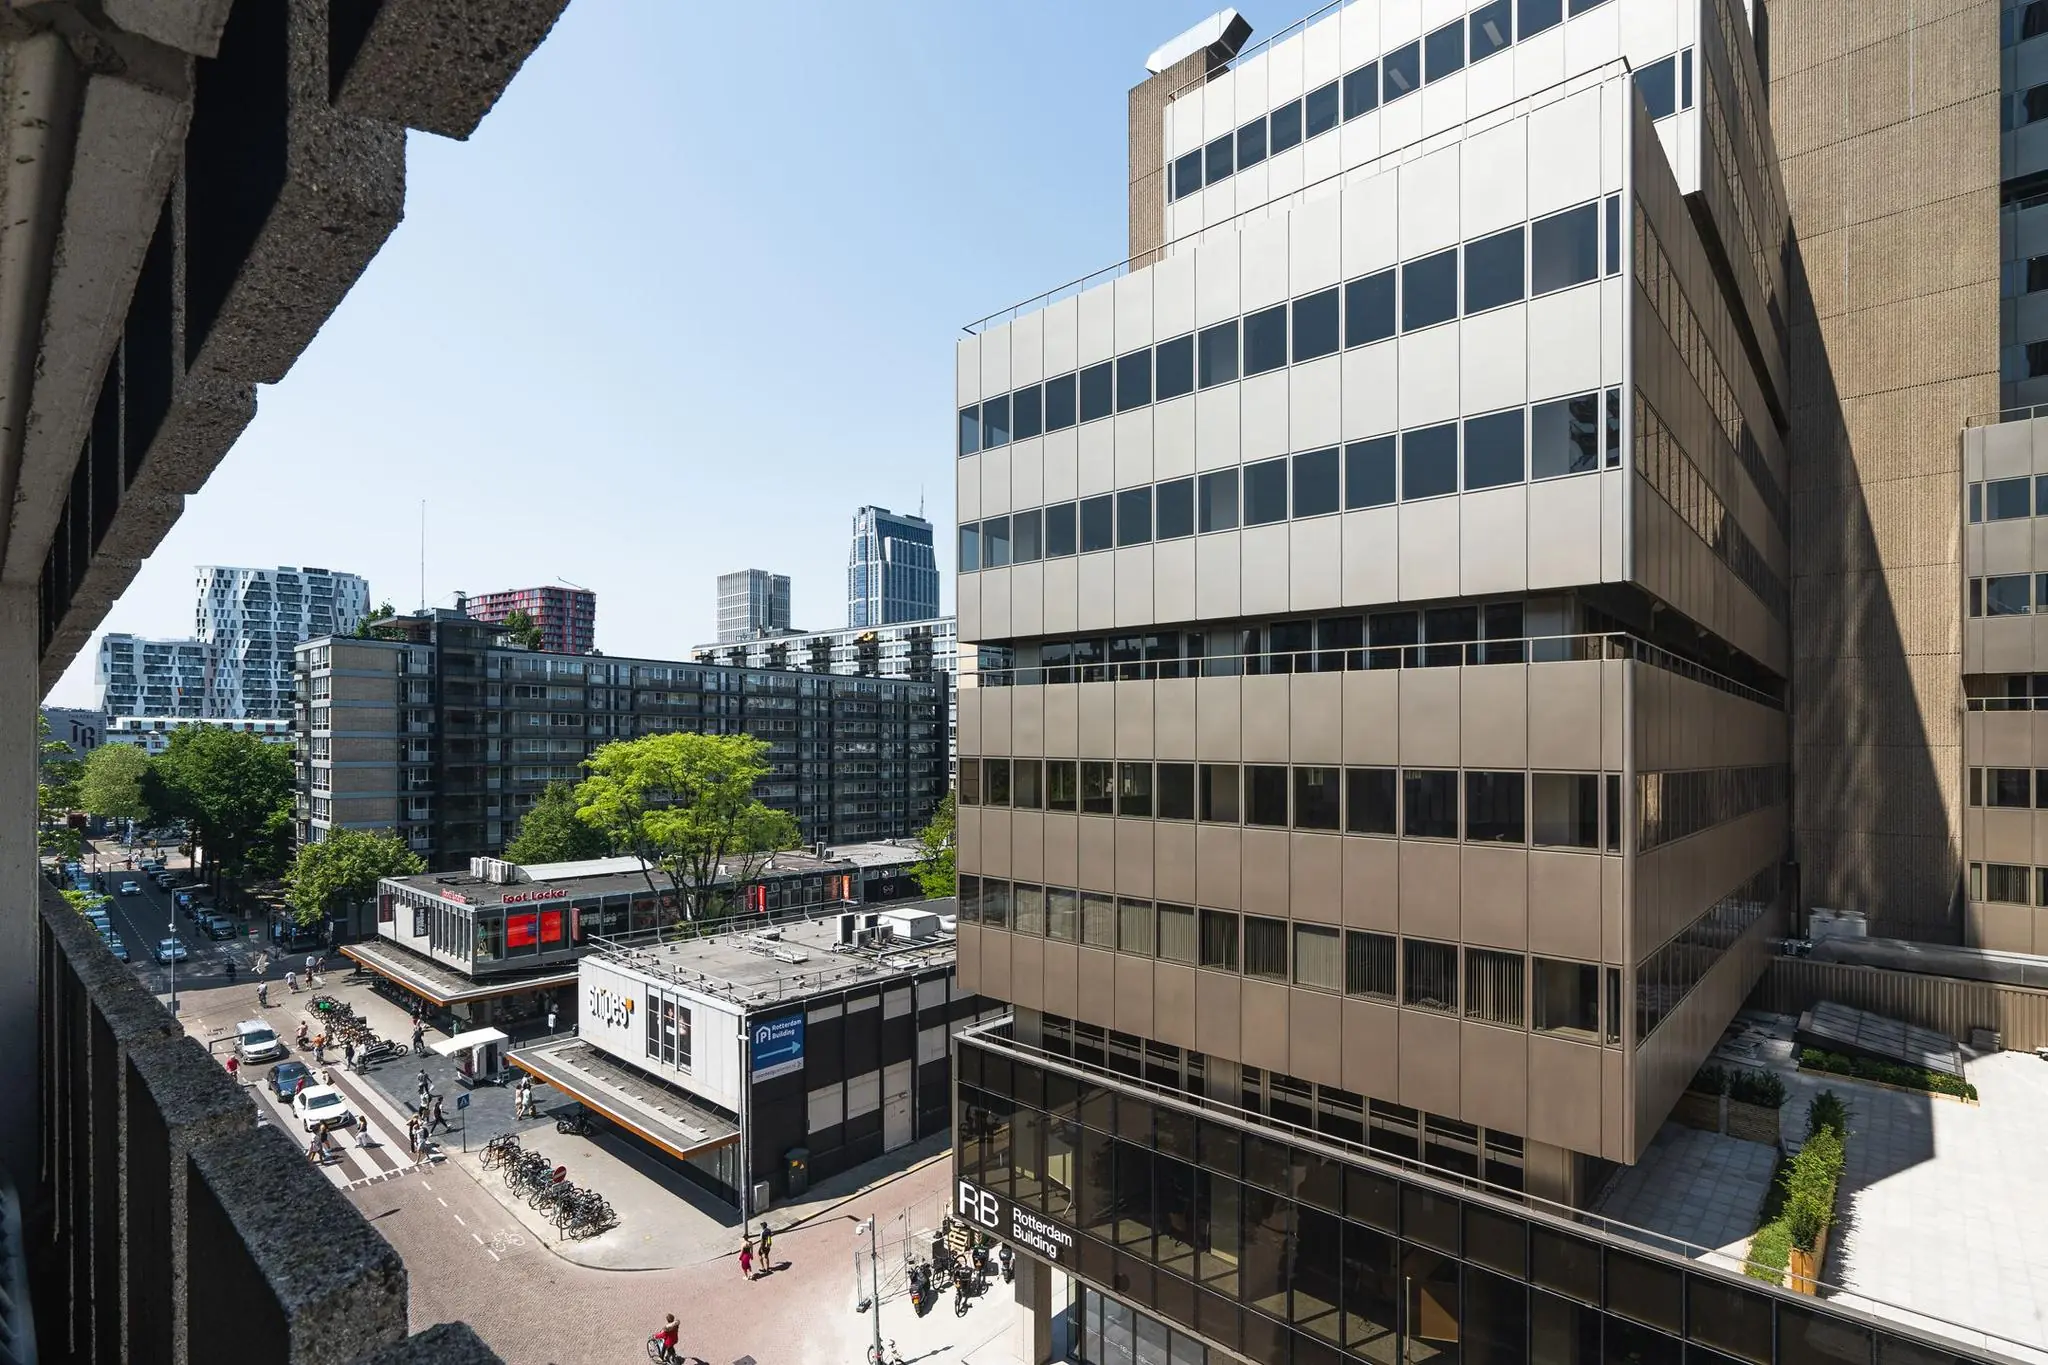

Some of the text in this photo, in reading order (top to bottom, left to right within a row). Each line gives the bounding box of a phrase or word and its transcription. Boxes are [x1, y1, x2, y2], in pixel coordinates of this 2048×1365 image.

[502, 889, 569, 904] Foot Locker
[588, 985, 630, 1027] snipes
[772, 1019, 801, 1030] Rotterdam
[772, 1029, 795, 1039] Building
[959, 1181, 999, 1228] RB
[1013, 1207, 1072, 1247] Rotterdam
[1013, 1224, 1057, 1259] Building
